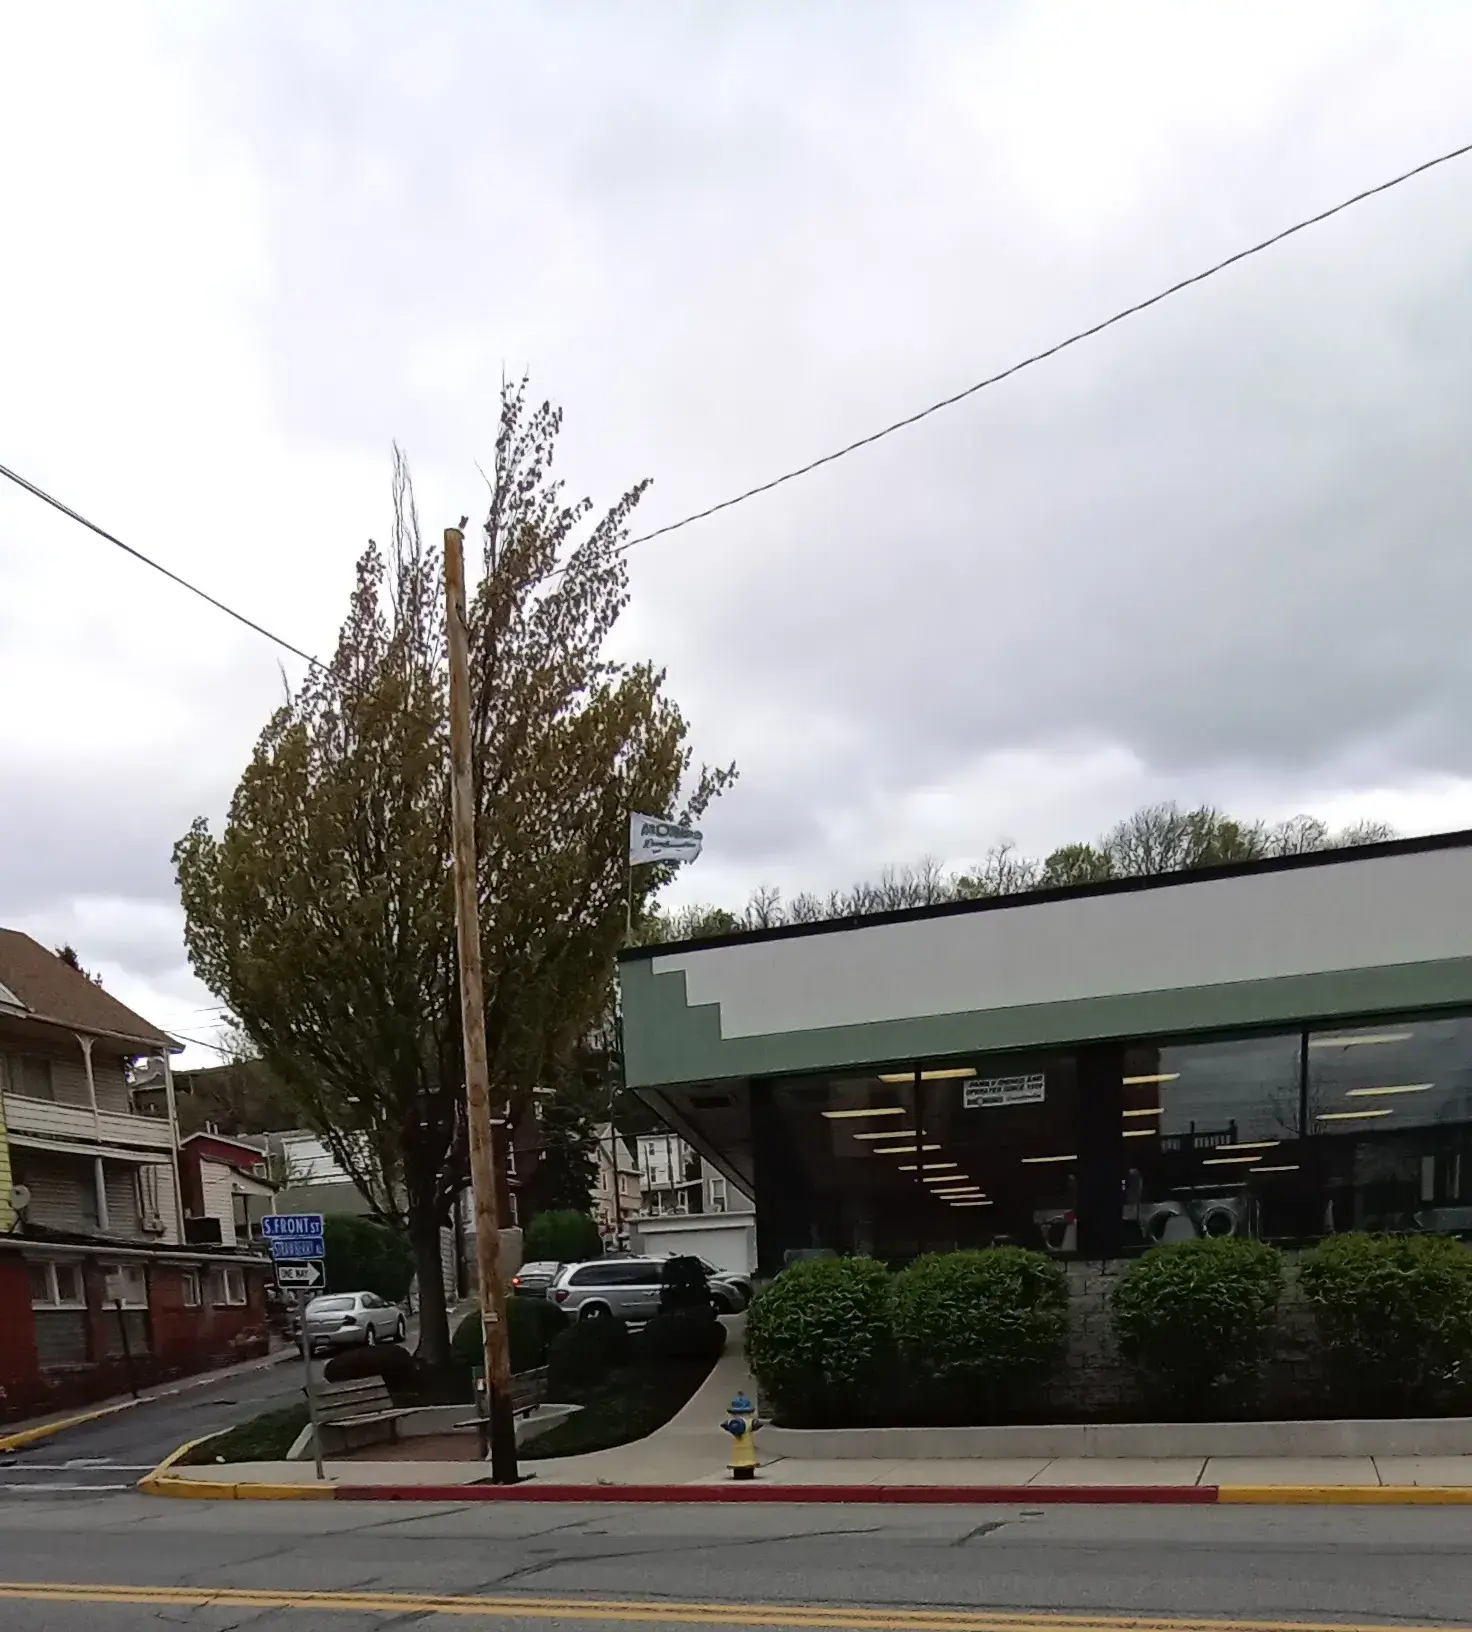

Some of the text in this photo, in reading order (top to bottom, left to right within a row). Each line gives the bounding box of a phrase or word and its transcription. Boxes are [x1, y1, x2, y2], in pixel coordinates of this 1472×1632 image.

[274, 1217, 309, 1234] FRONT
[310, 1222, 320, 1233] ST
[274, 1240, 314, 1257] STRAWBERRY
[281, 1268, 308, 1278] ONE WAY
